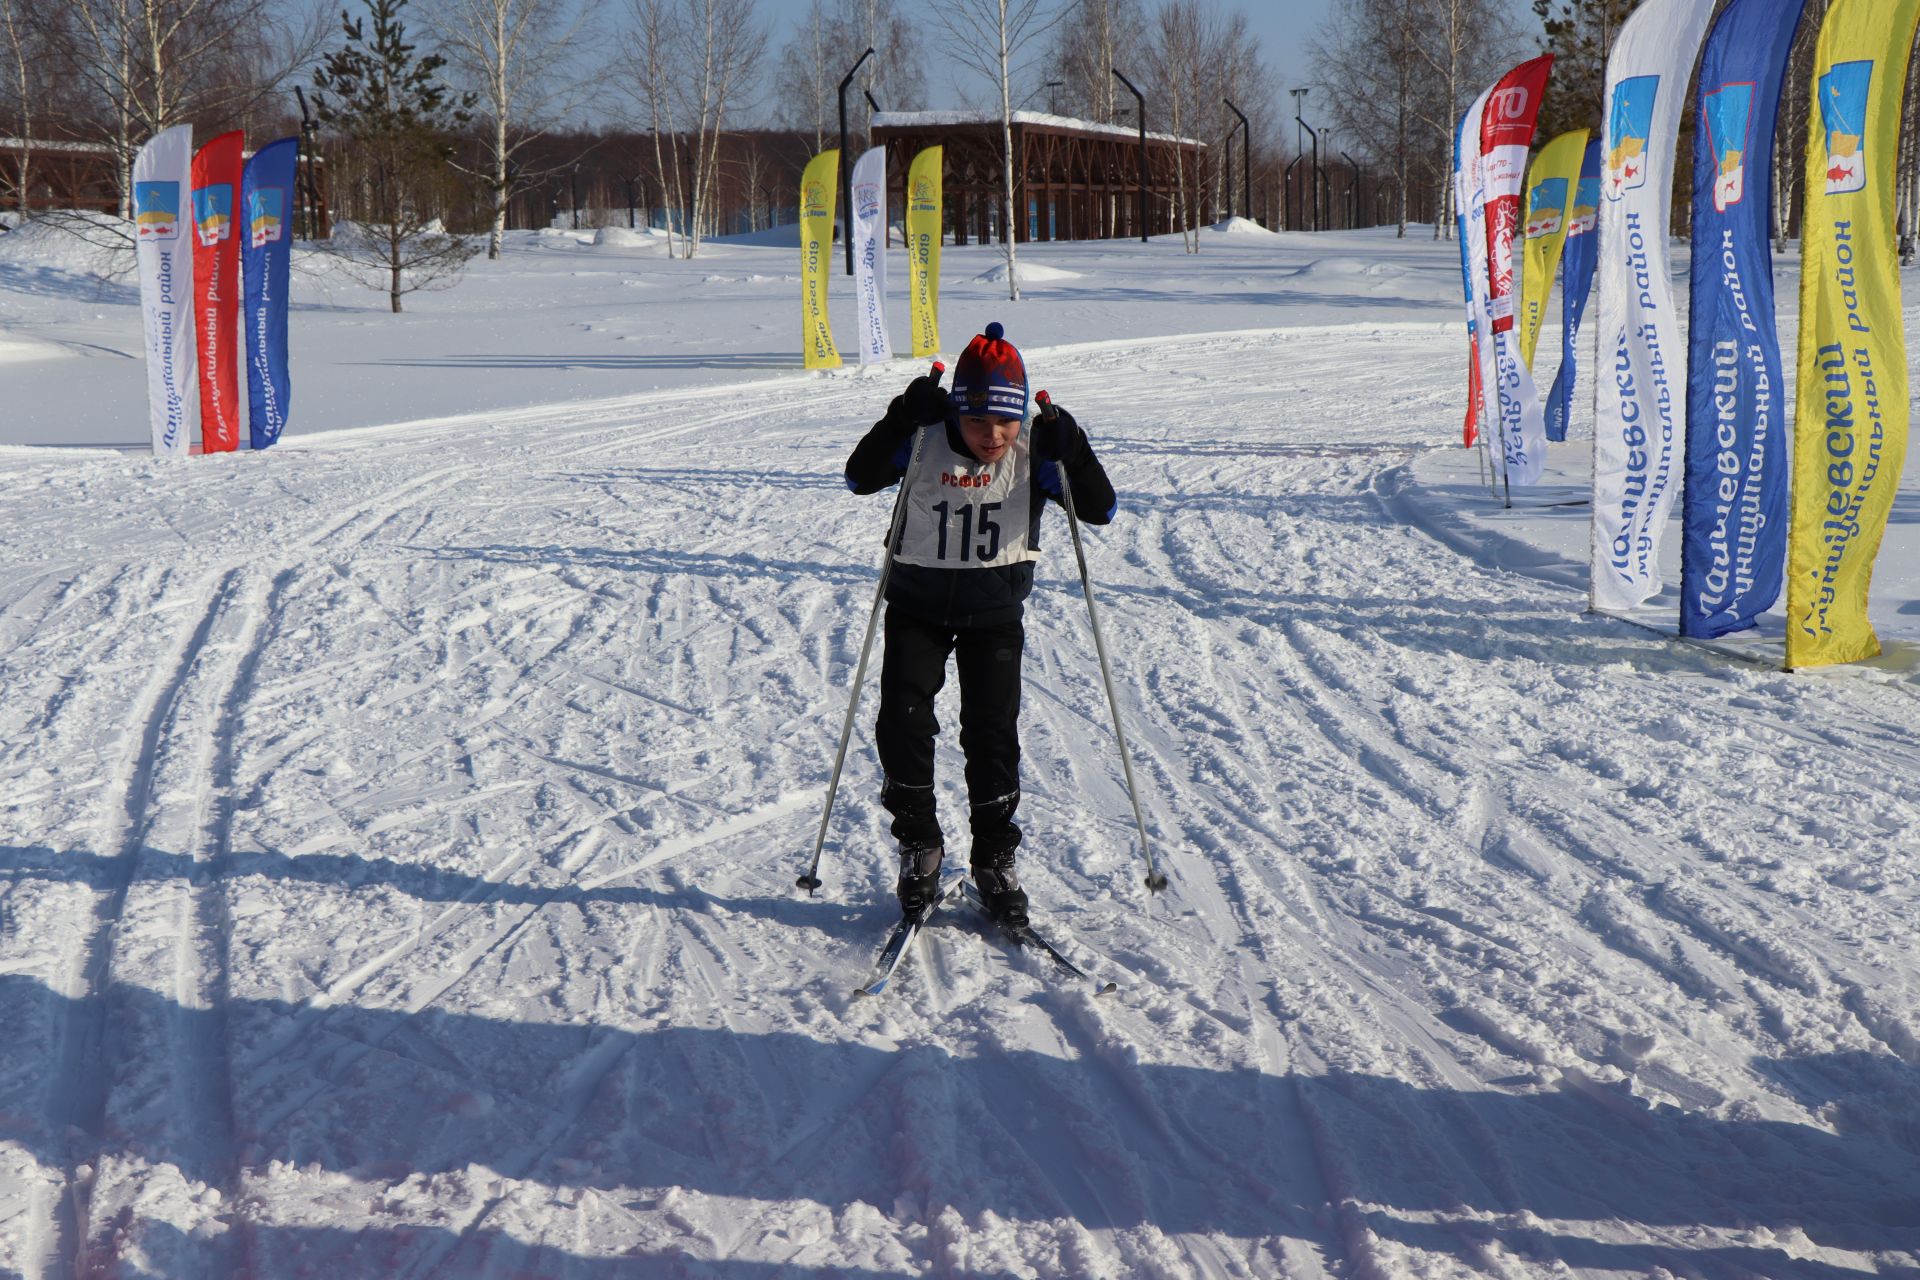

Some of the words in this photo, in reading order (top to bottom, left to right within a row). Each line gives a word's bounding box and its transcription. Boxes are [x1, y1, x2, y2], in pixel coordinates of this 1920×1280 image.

[156, 251, 173, 304] район
[809, 240, 819, 273] 2019
[919, 234, 930, 265] 2019
[1626, 213, 1658, 310] район
[1721, 229, 1756, 332] район
[1834, 221, 1870, 332] район
[941, 472, 991, 488] РСФСР
[1724, 344, 1770, 619] муниципальный
[932, 500, 1002, 562] 115
